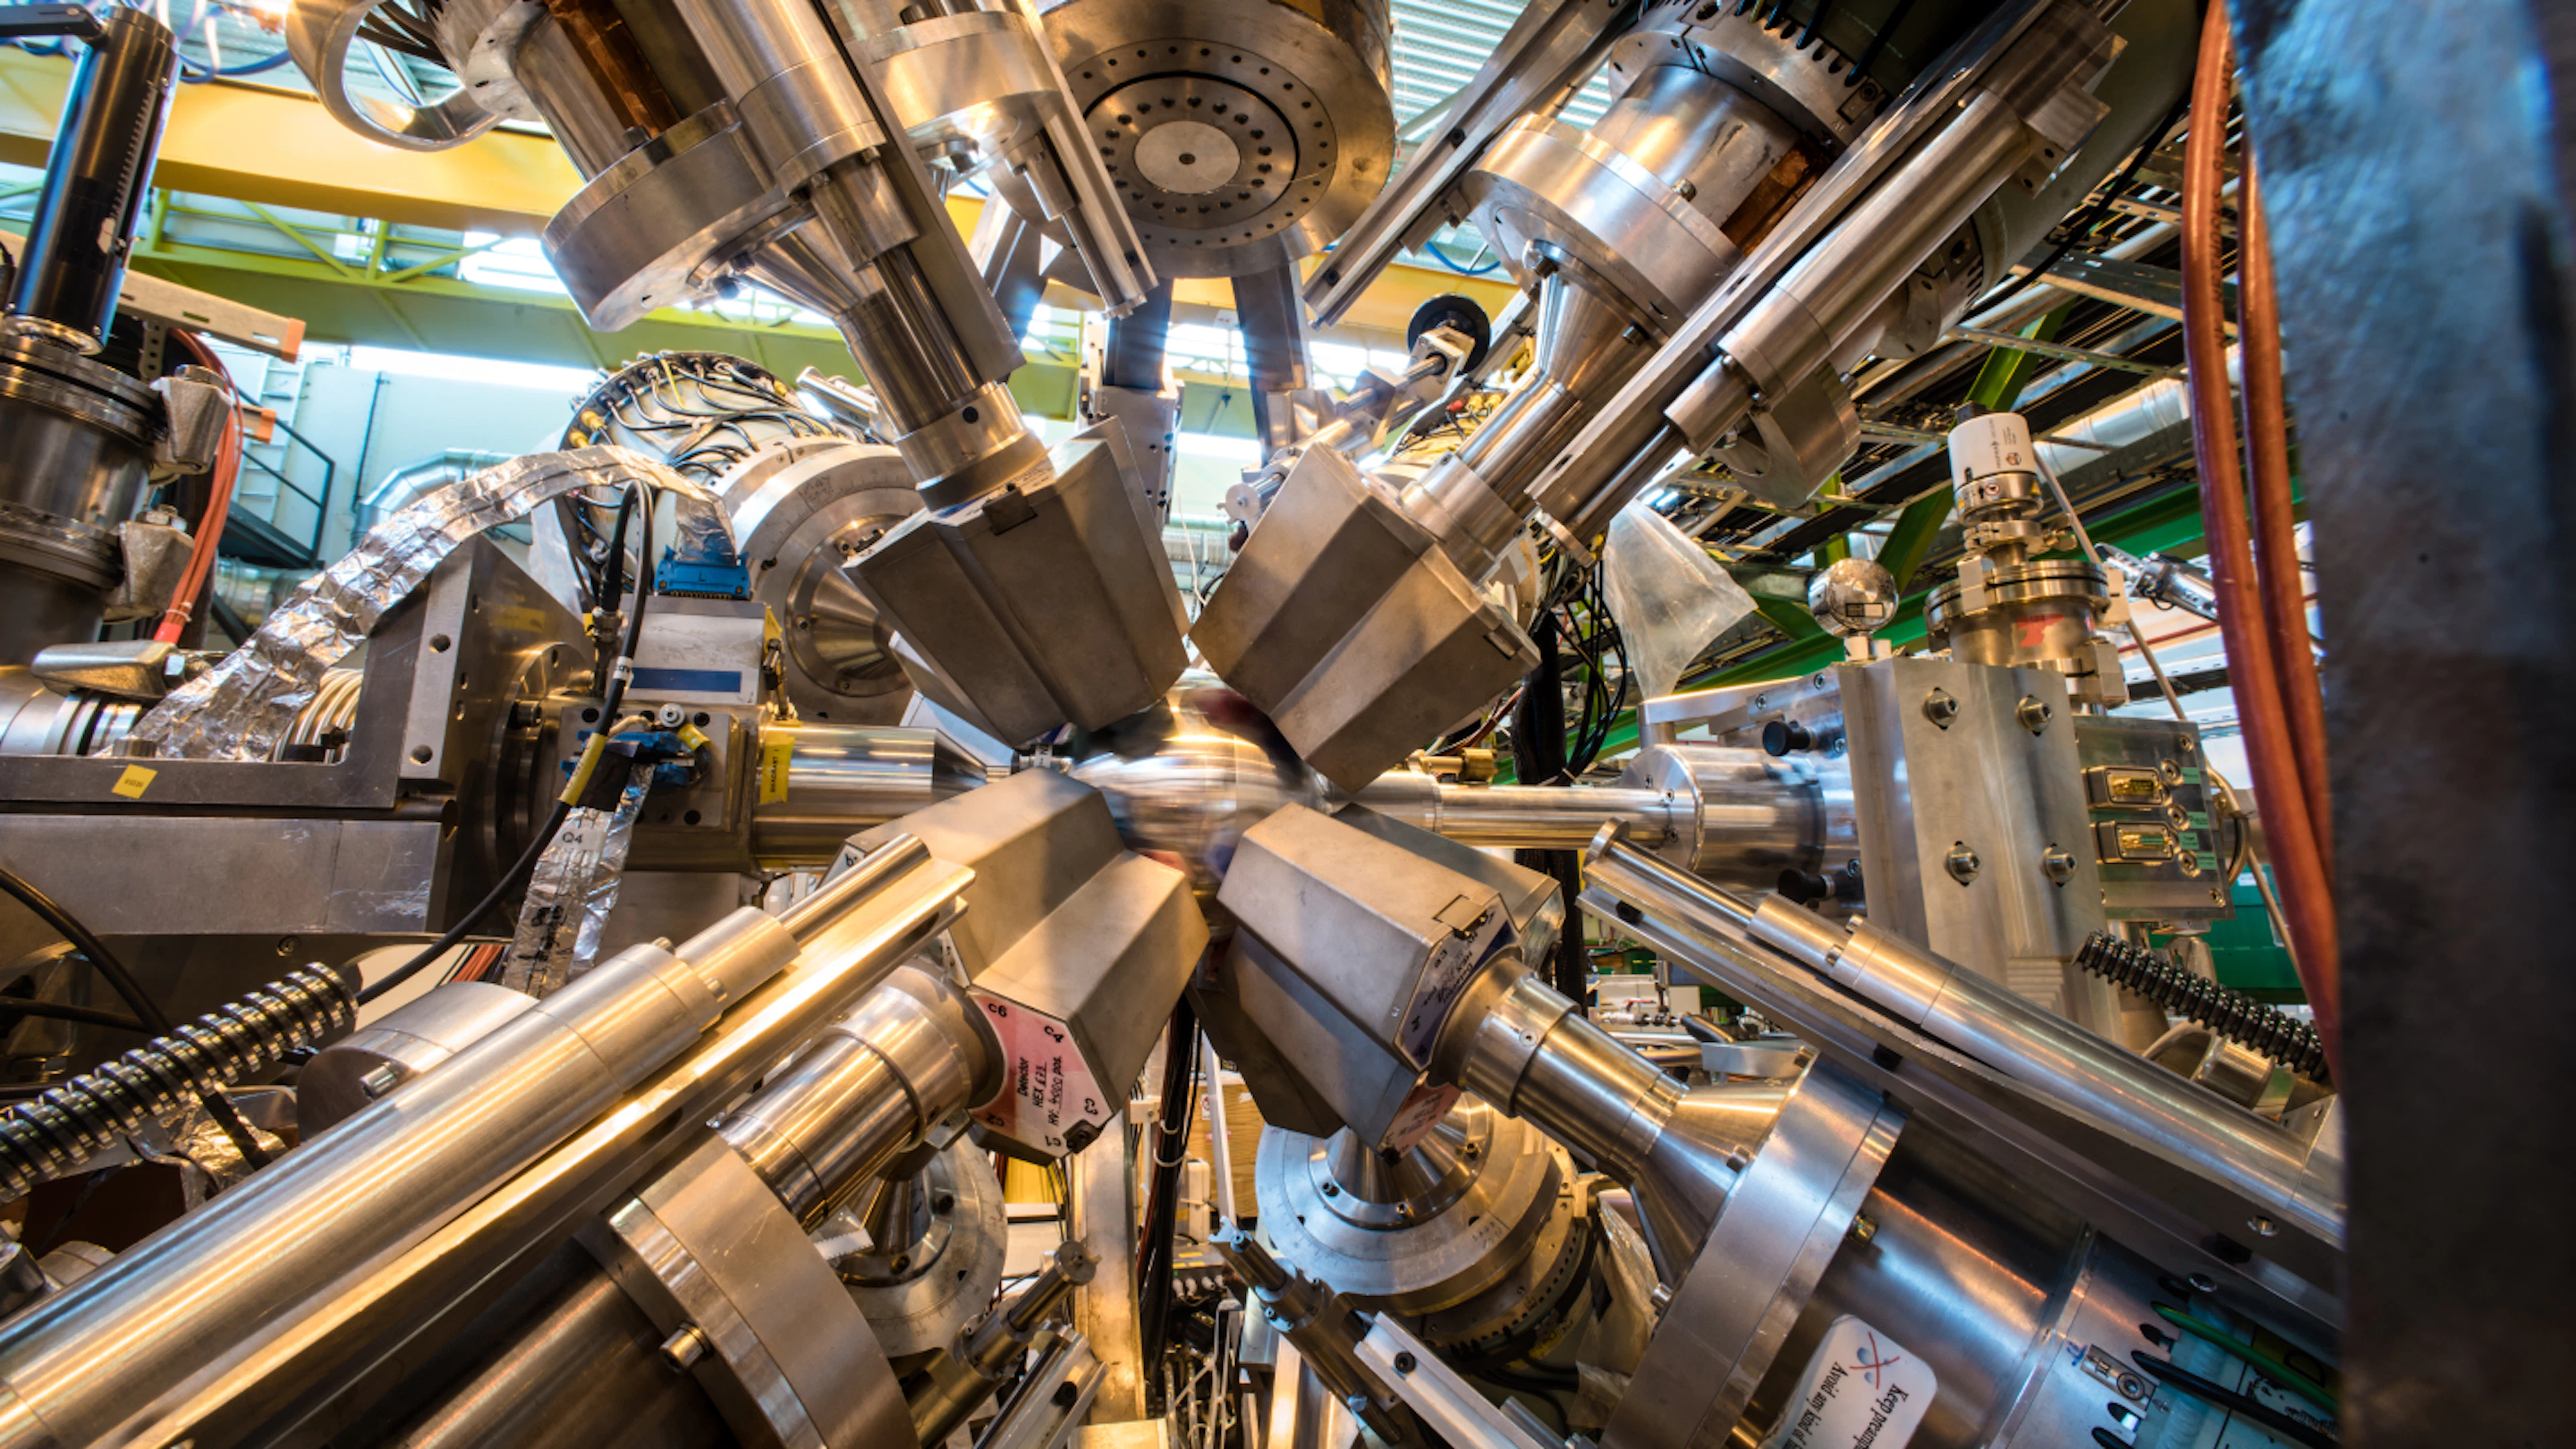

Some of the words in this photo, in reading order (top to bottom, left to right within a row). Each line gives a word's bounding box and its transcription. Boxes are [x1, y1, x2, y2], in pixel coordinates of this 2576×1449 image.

[562, 831, 583, 844] Q4
[1032, 1086, 1044, 1108] HEX
[1821, 1361, 1848, 1399] Avoid
[1806, 1391, 1827, 1413] any
[1876, 1383, 1909, 1414] Keep
[1797, 1407, 1822, 1435] kind
[1853, 1407, 1888, 1449] preamp
[1792, 1428, 1807, 1446] of
